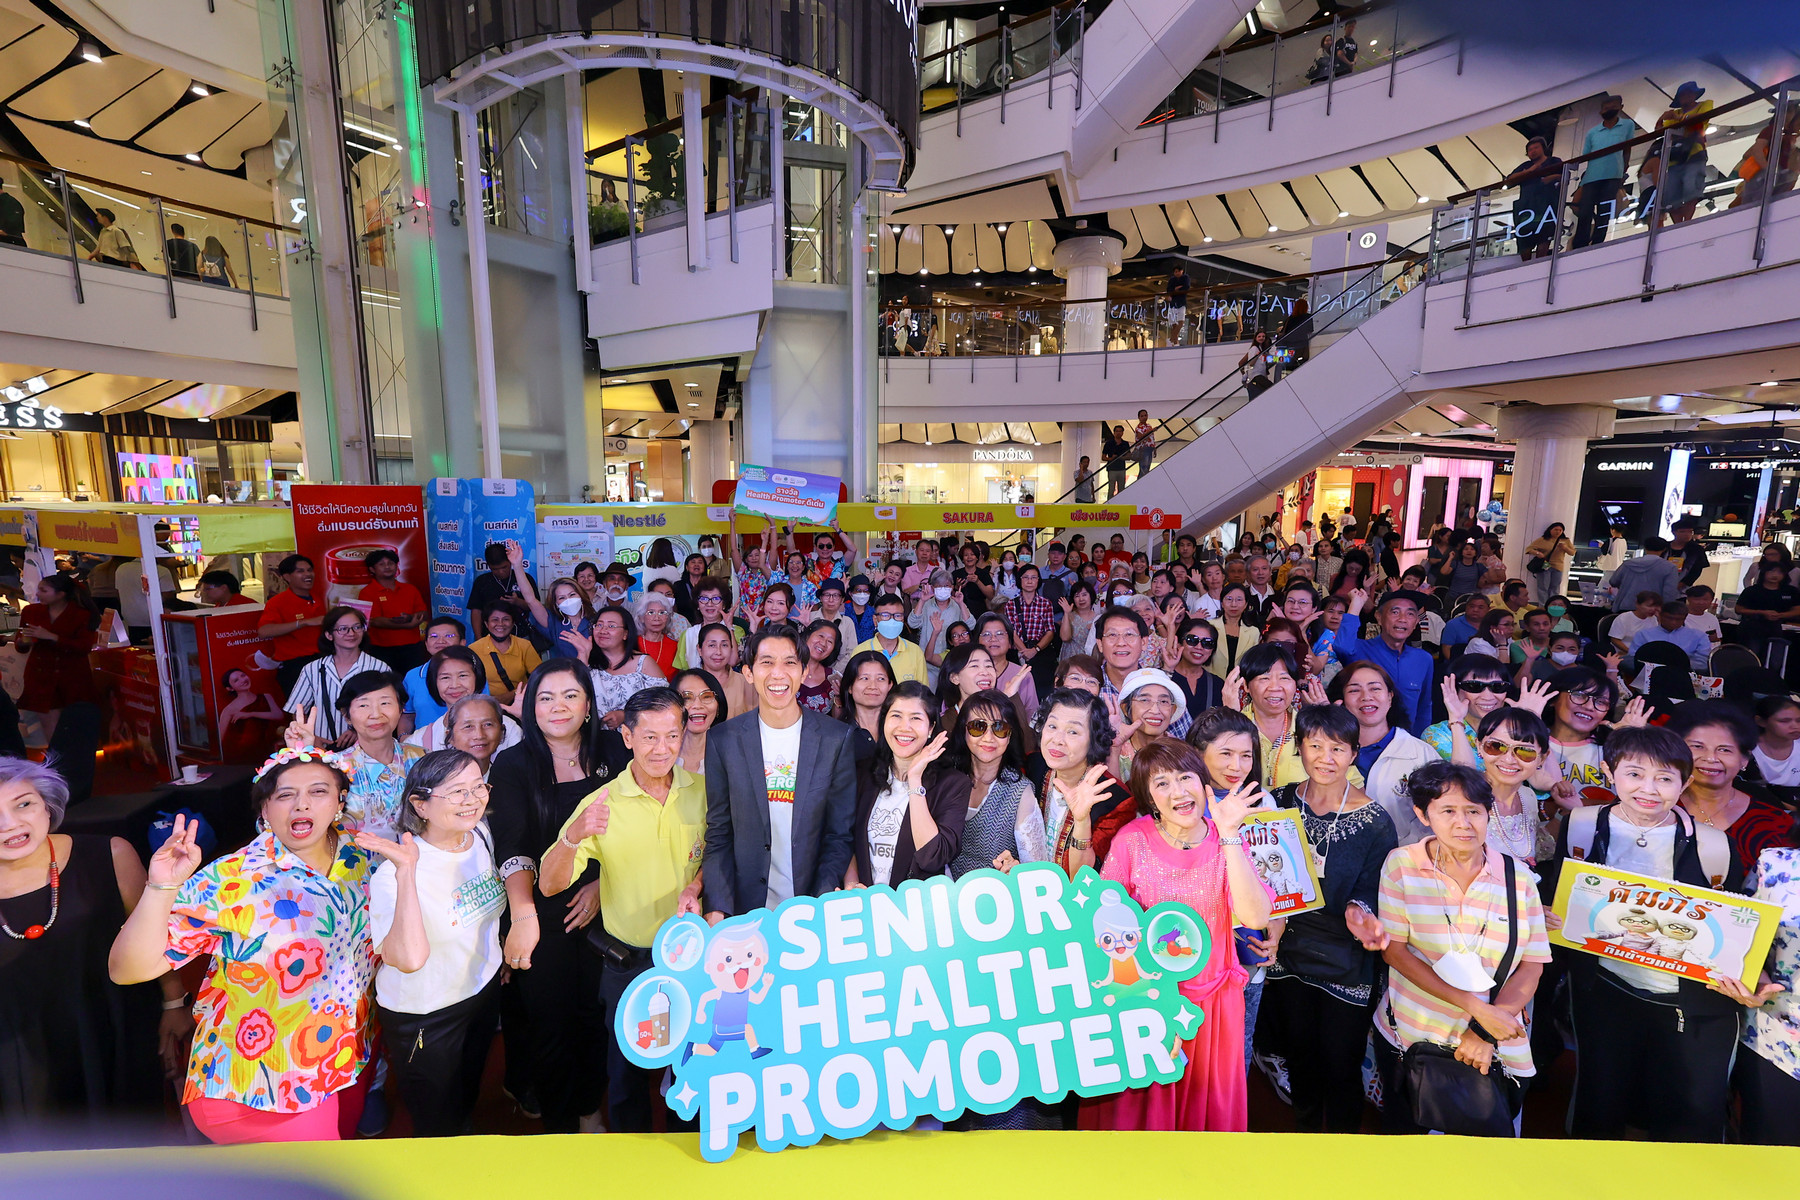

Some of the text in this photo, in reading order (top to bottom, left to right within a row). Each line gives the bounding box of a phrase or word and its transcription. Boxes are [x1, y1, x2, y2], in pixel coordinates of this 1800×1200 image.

[973, 448, 1033, 461] PANDORA
[1597, 461, 1654, 471] GARMIN
[1730, 461, 1780, 470] TISSOT
[746, 490, 771, 500] Health
[771, 494, 805, 505] Promoter
[776, 487, 798, 496] รางวัล
[297, 502, 417, 516] ใช้ชีวิตให้มีความสุขในทุกวัน
[317, 517, 419, 532] ดื่มแบรนด์รังนกแท้
[484, 519, 518, 531] เนสท์เล่
[551, 517, 579, 527] ภารกิจ
[612, 513, 666, 528] Nestlé
[943, 511, 994, 524] SAKURA
[767, 790, 795, 801] TIVAL
[869, 842, 895, 859] Nest
[461, 869, 493, 894] SENIOR
[464, 876, 498, 905] HEALTH
[1607, 880, 1722, 921] คัมภีร์
[778, 868, 1072, 971] SENIOR
[779, 942, 1093, 1054] HEALTH
[707, 1007, 1176, 1152] PROMOTER
